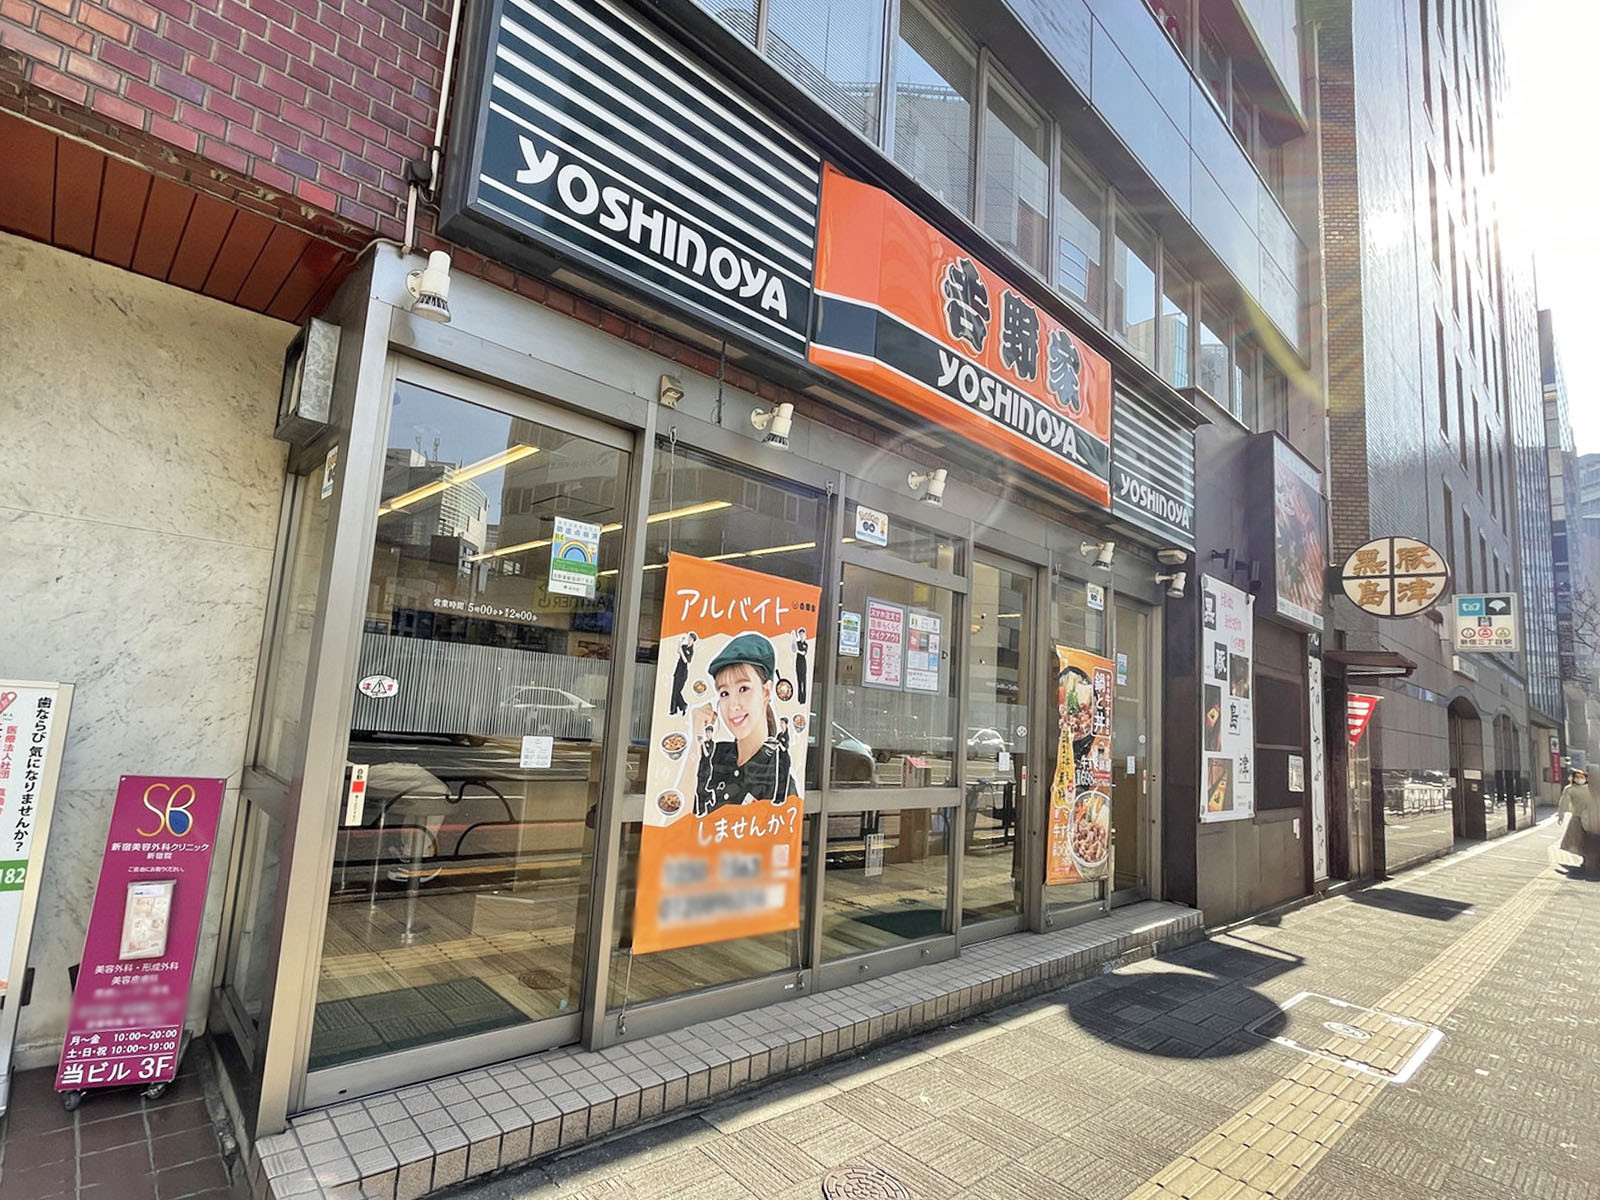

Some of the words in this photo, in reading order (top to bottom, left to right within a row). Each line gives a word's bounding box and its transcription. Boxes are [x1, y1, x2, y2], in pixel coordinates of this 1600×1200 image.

[516, 135, 787, 319] YOSHINOYA
[939, 256, 1081, 413] 吉野家
[938, 350, 1081, 462] YOSHINOYA
[1120, 473, 1190, 529] YOSHINOYA
[677, 588, 789, 625] アルバイト
[31, 697, 52, 744] 歯ならび
[13, 745, 43, 852] 気になりませんか?
[111, 842, 209, 853] 新宿美容外科クリニック
[698, 807, 798, 846] しませんか?
[62, 1061, 131, 1084] 当ビル
[138, 1056, 173, 1079] 3F
